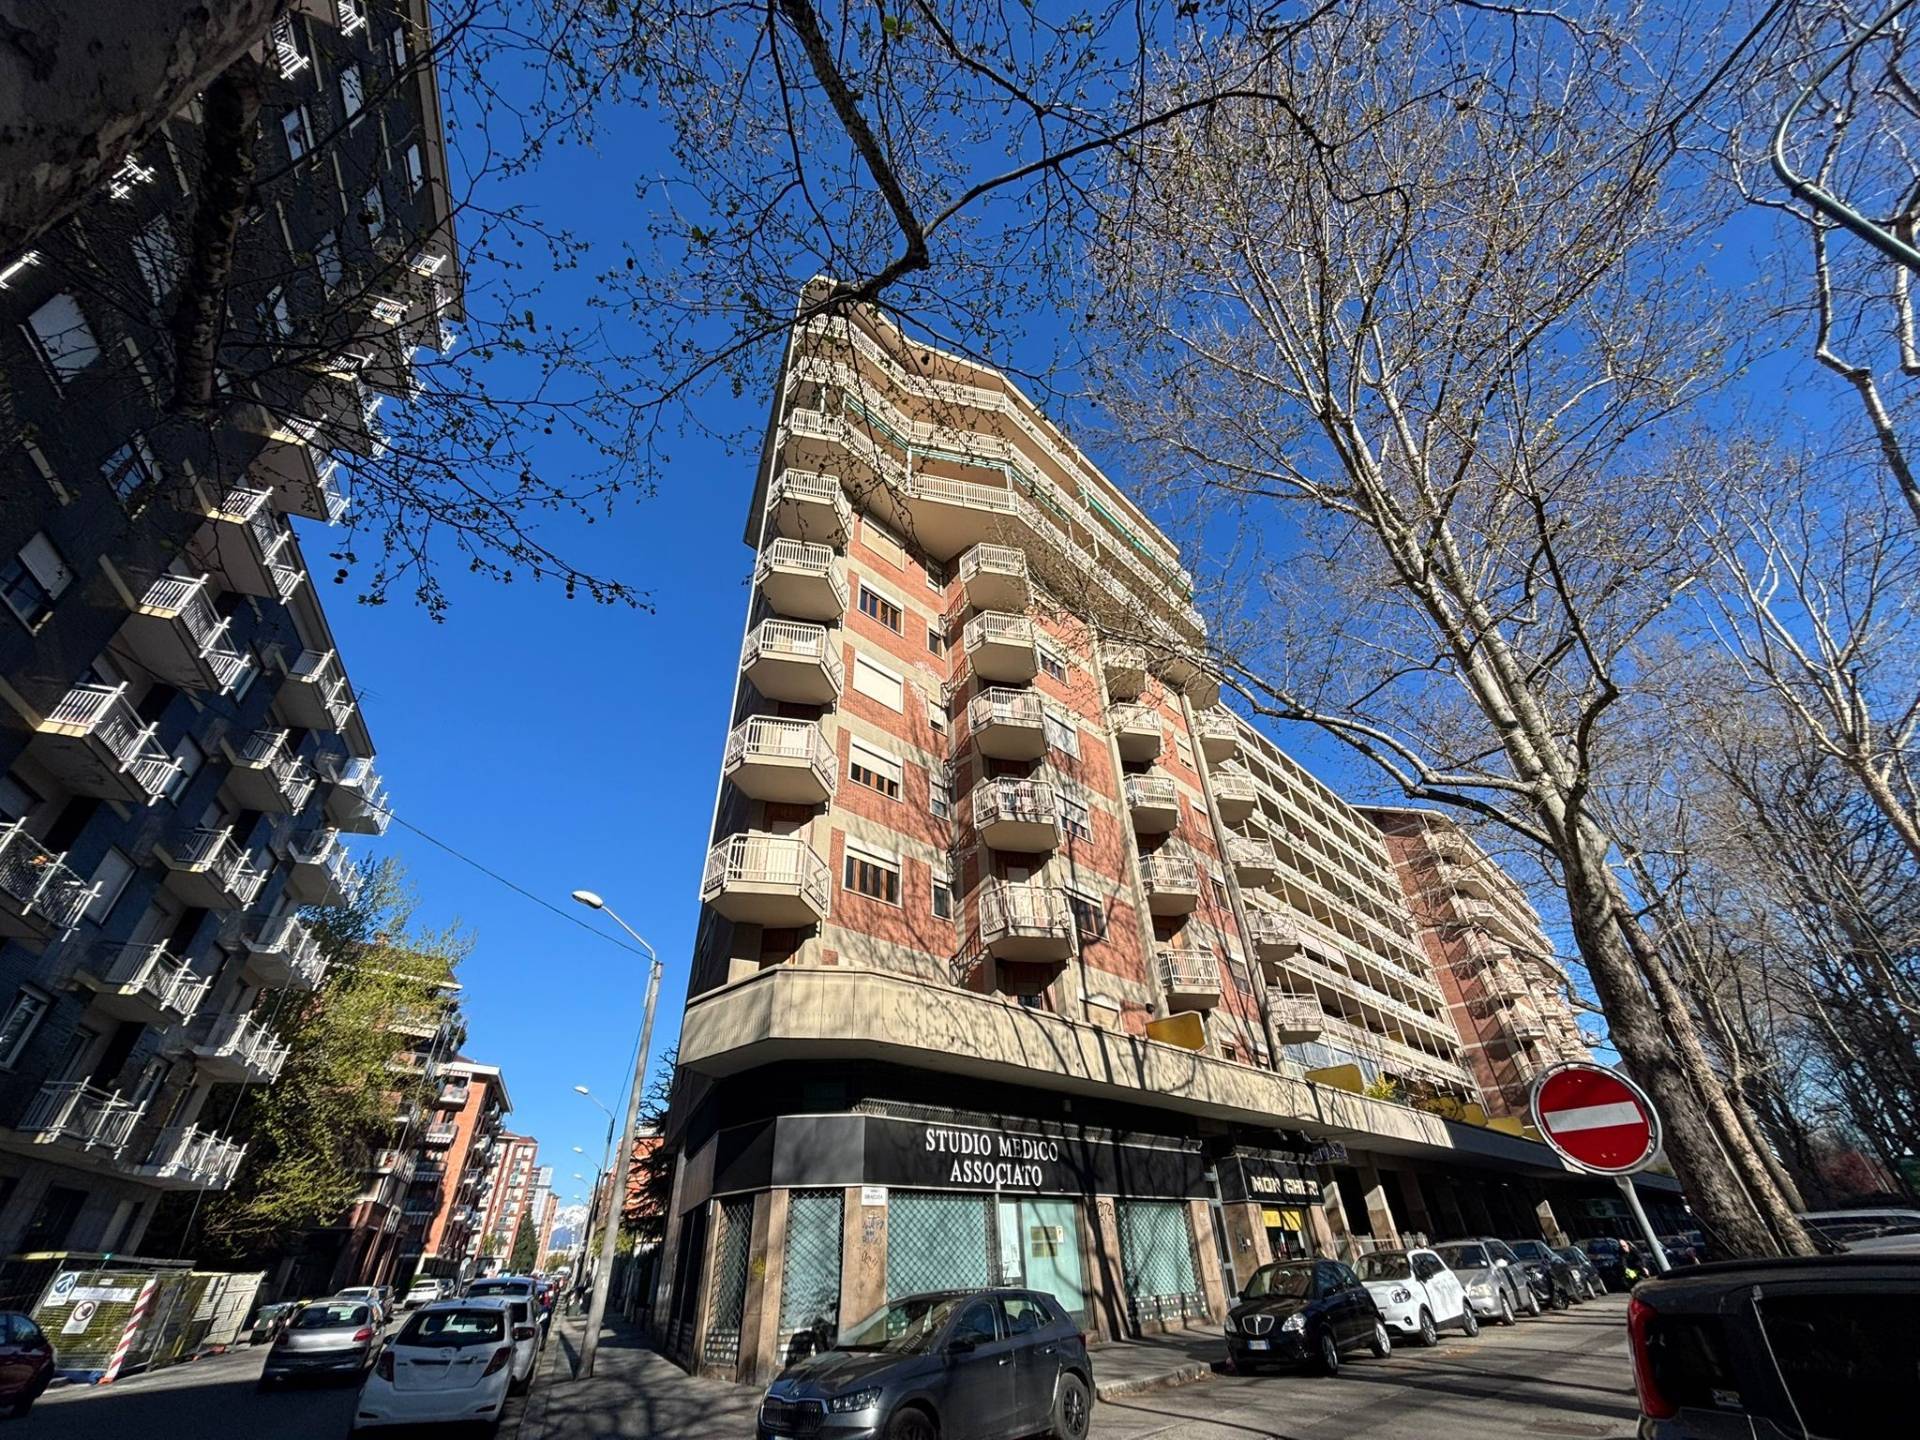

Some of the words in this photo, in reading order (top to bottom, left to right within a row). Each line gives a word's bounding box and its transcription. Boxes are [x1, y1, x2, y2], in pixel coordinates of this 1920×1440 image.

[926, 1128, 991, 1156] STUDIO
[999, 1136, 1058, 1162] MEDICO
[950, 1159, 1042, 1187] ASSOCIATO
[1250, 1175, 1281, 1193] MON
